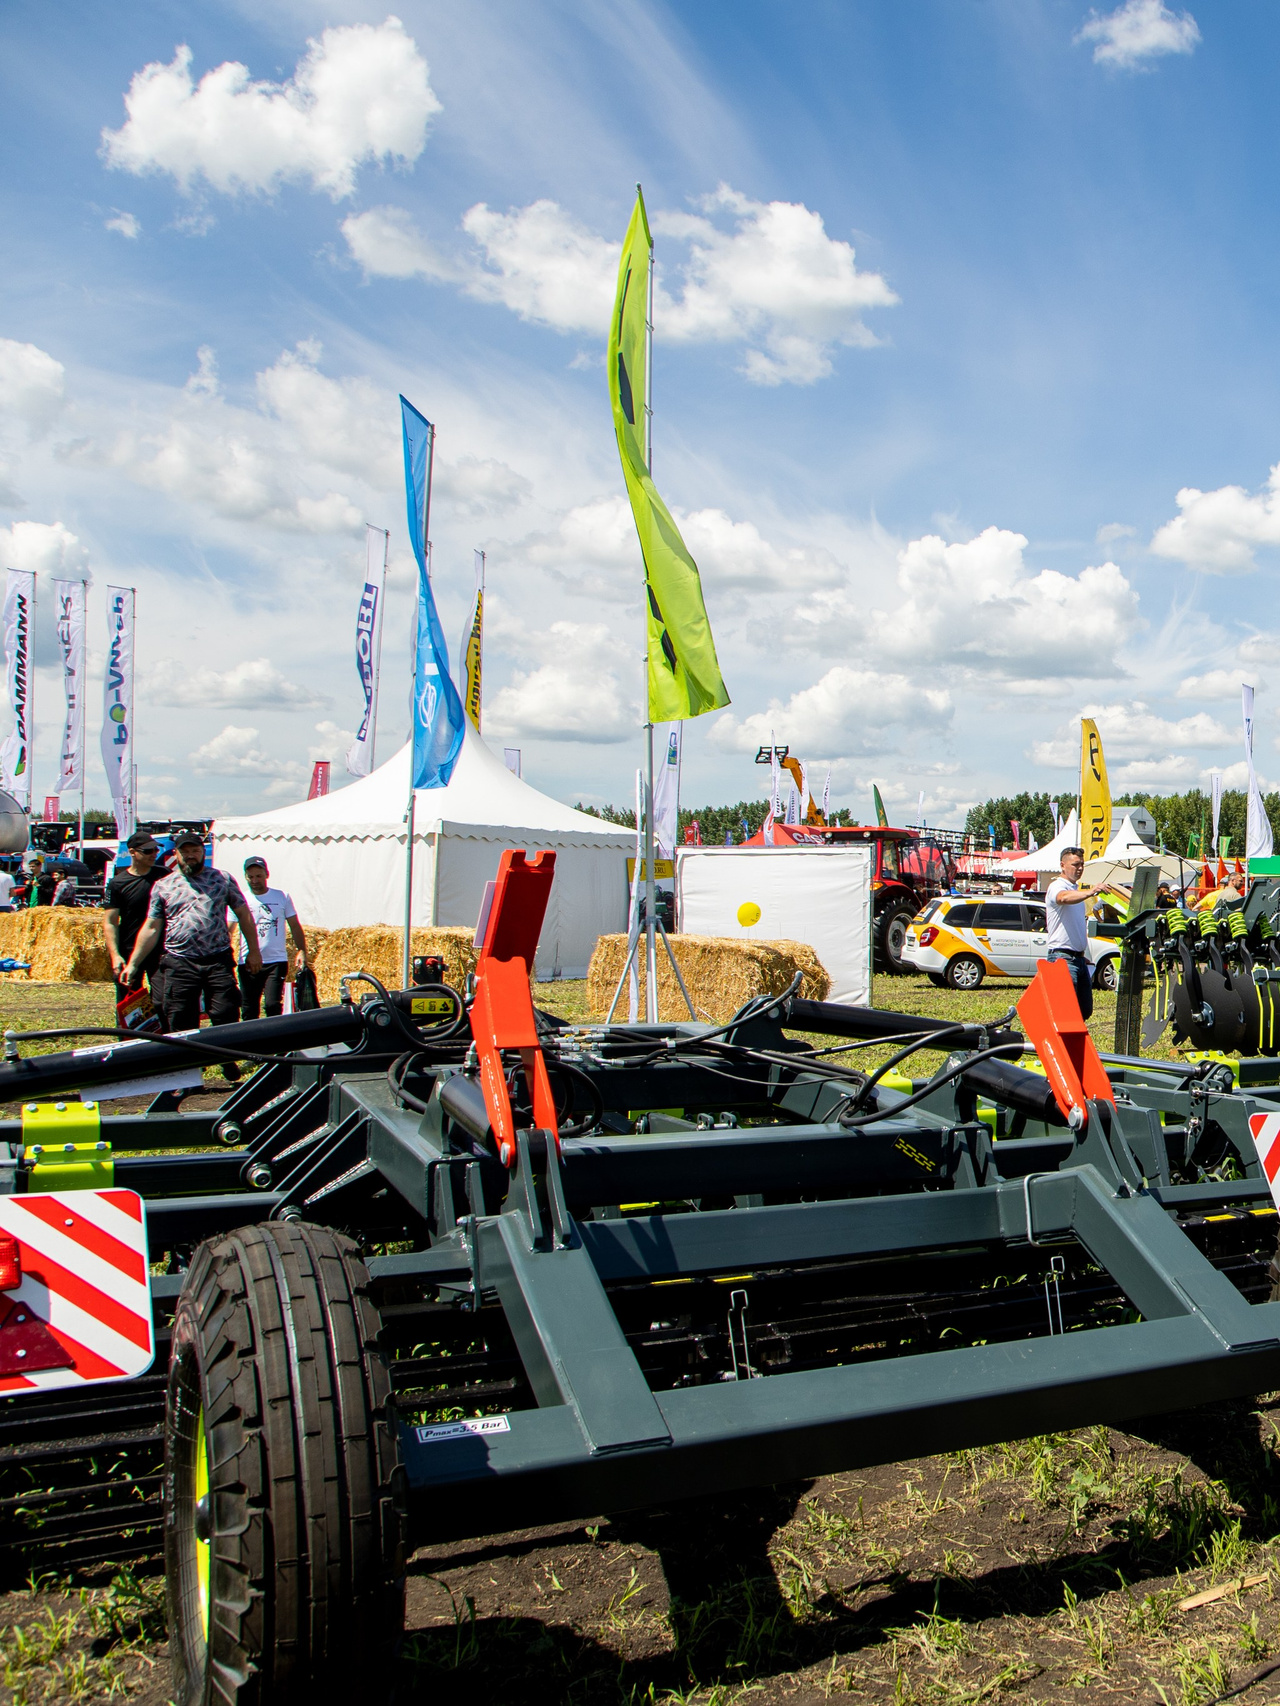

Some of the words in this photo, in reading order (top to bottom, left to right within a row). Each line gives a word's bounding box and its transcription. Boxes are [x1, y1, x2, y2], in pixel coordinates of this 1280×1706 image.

[14, 593, 28, 742] DAMMANN
[424, 1424, 478, 1438] Pmax=3.5
[481, 1421, 502, 1430] Bar
